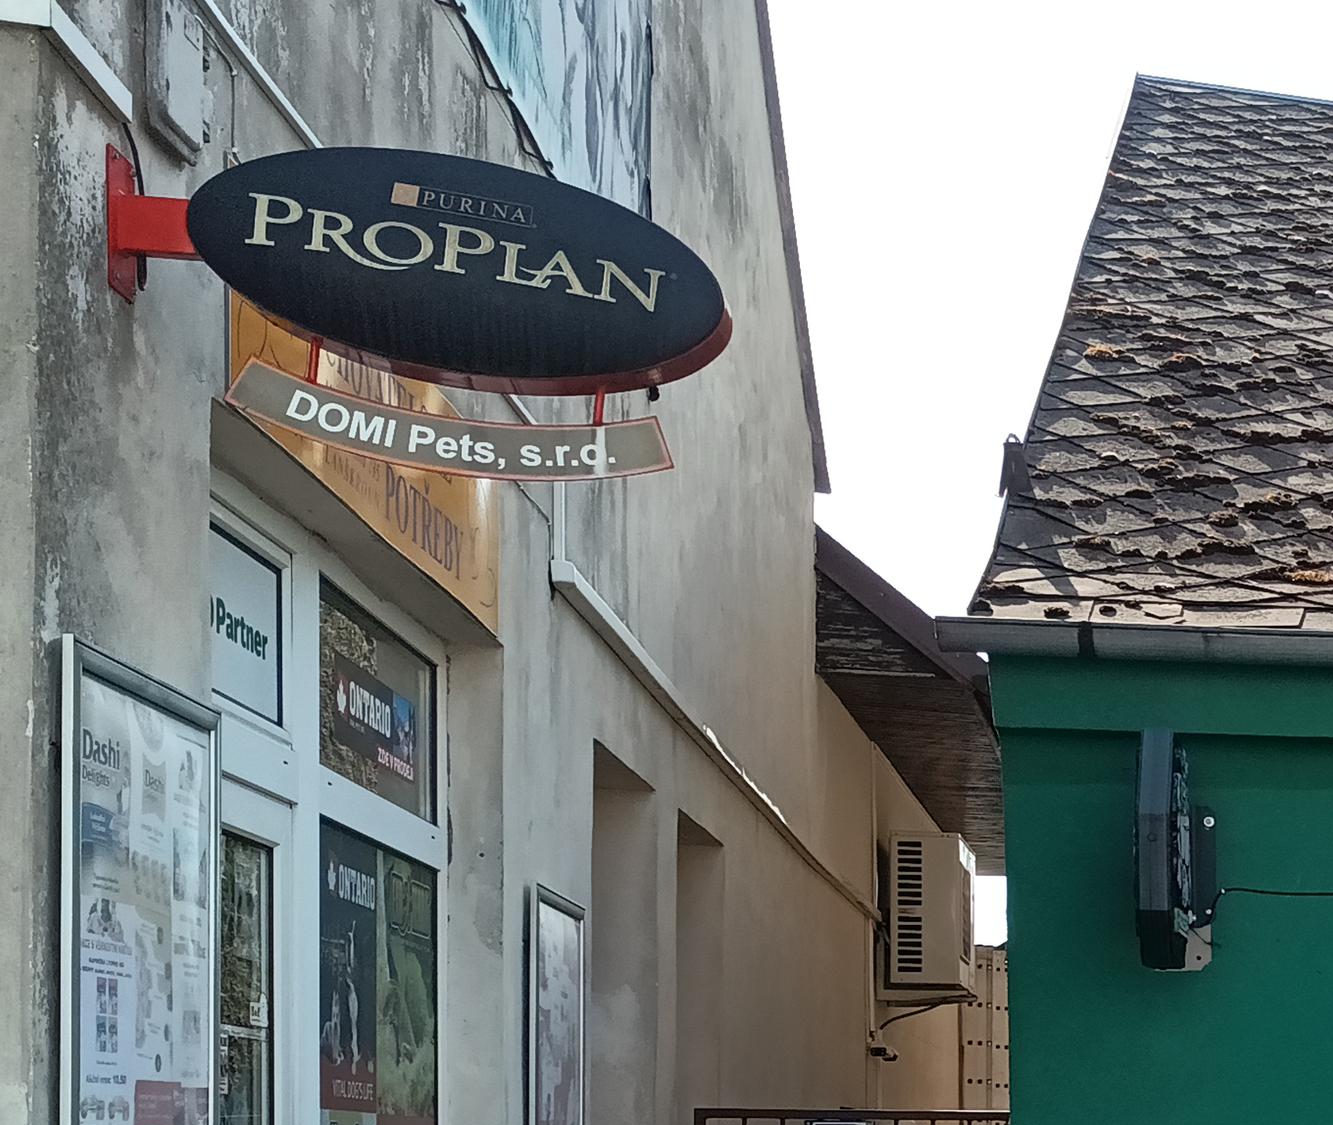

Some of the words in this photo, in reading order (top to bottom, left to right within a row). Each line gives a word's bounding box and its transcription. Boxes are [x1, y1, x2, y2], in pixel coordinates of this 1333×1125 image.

[422, 190, 527, 223] PURINA
[286, 389, 397, 448] DOMI
[408, 424, 506, 470] Pets,
[520, 441, 617, 468] s.r.o.
[385, 462, 465, 581] POTŘEBY
[215, 597, 268, 661] Partner
[350, 681, 391, 738] ONTARIO
[82, 729, 120, 770] Dashi
[339, 864, 376, 911] ONTARIO
